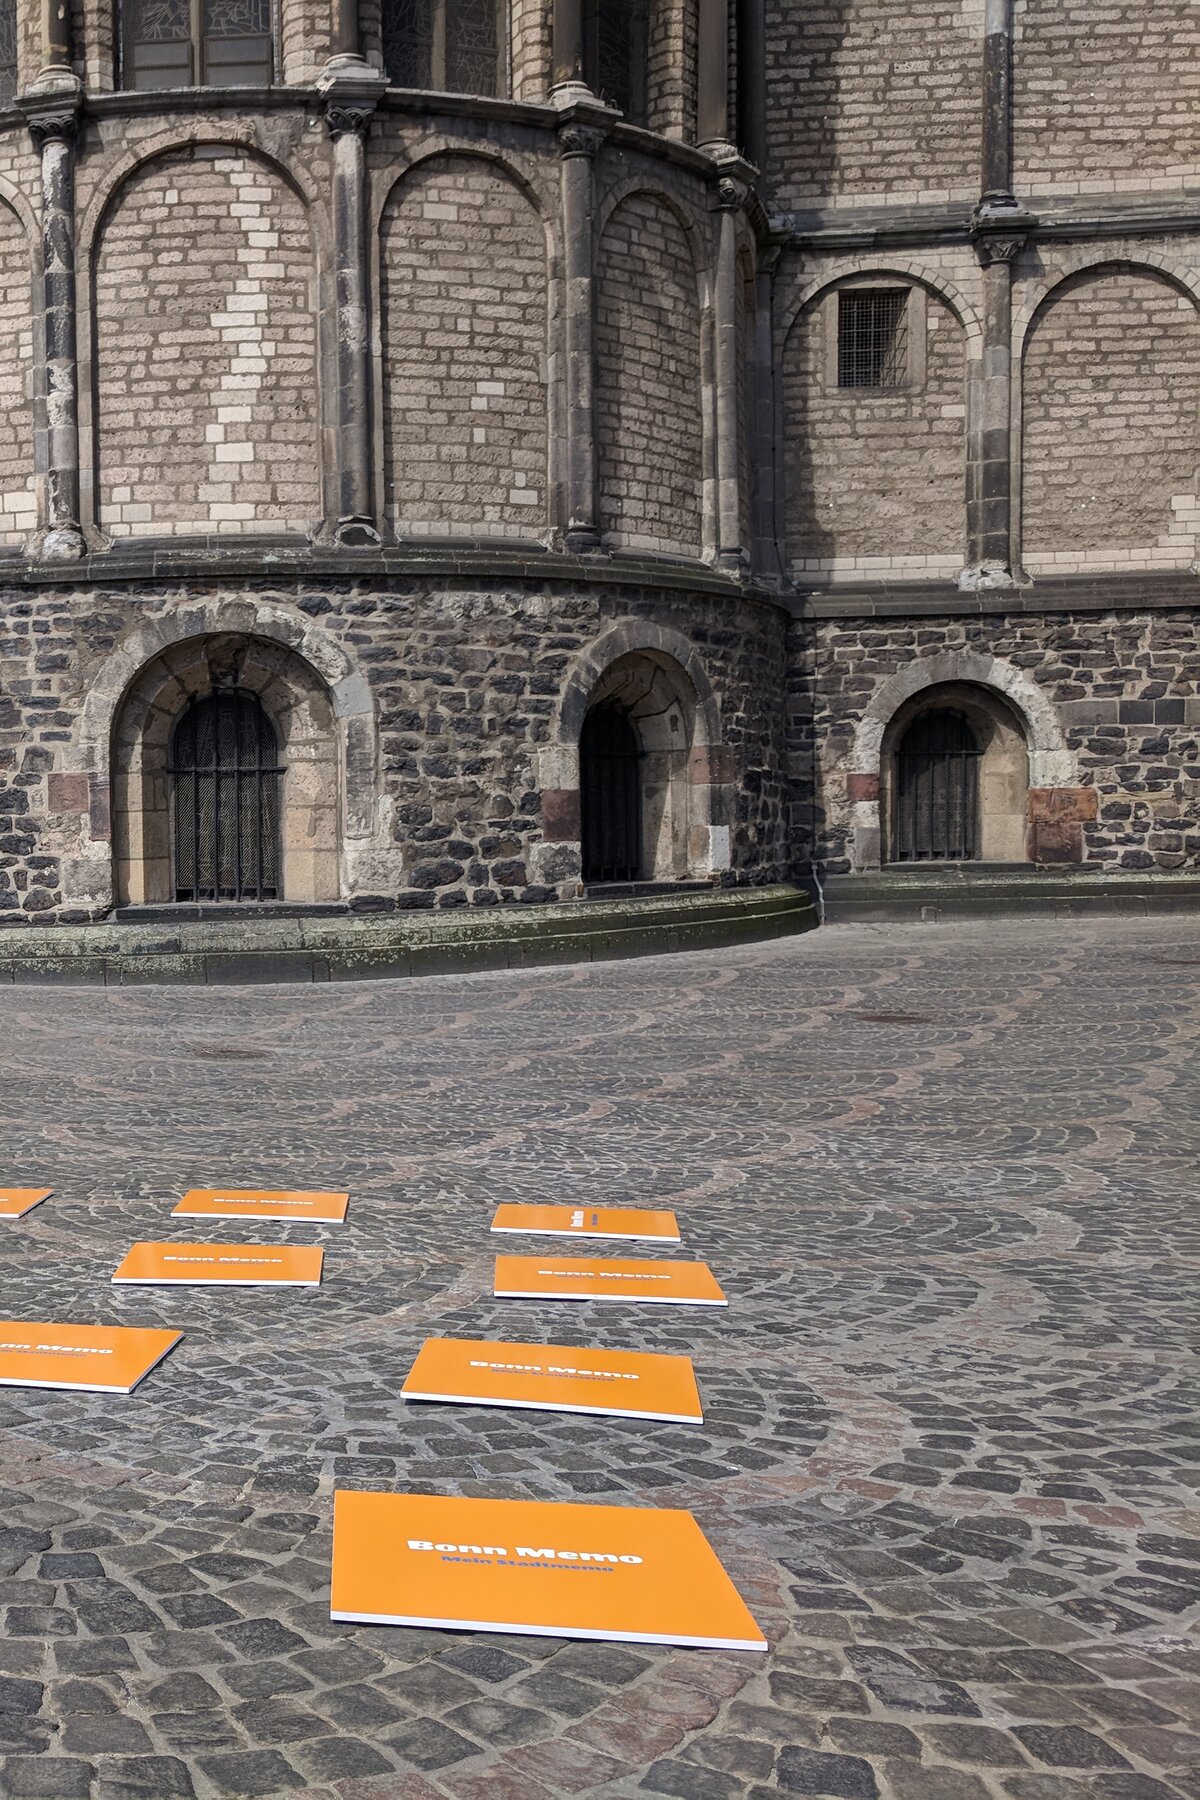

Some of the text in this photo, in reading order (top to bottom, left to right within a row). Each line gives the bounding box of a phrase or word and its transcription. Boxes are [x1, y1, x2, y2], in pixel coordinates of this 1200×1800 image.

[406, 1539, 644, 1564] Bonn Memo
[441, 1555, 614, 1572] Mein Stadtmemo
